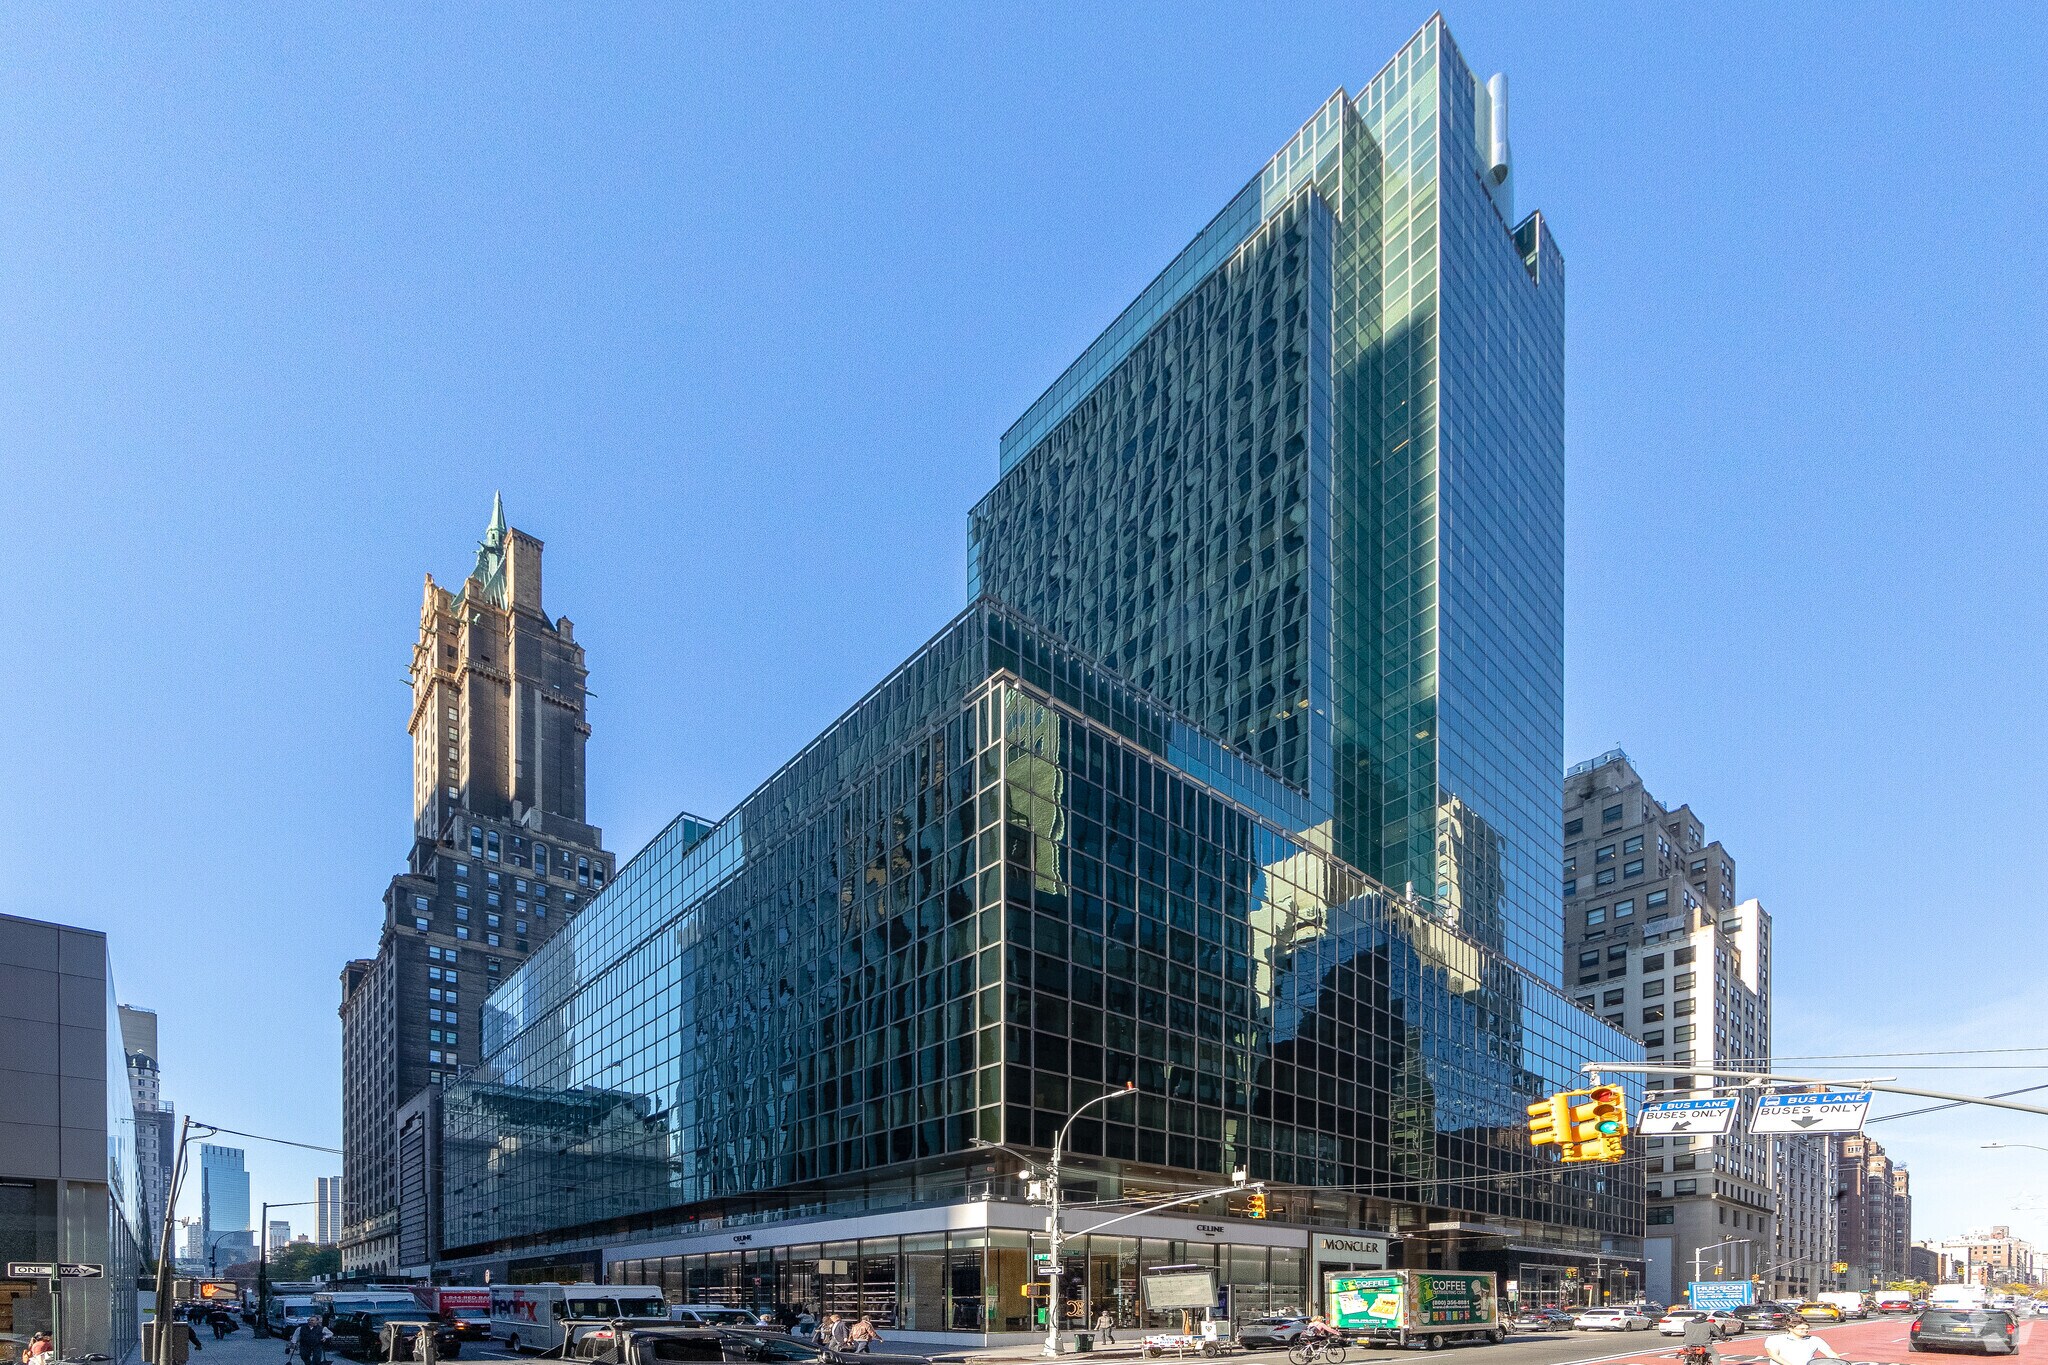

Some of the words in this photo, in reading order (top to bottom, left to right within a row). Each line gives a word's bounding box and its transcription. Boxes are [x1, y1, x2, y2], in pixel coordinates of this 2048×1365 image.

[1787, 1096, 1818, 1104] BUS
[1822, 1093, 1866, 1102] LANE
[1666, 1102, 1691, 1110] BUS
[1694, 1100, 1729, 1109] LANE
[1760, 1106, 1811, 1116] BUSES
[1819, 1104, 1863, 1113] ONLY
[1646, 1111, 1687, 1120] BUSES
[1691, 1109, 1727, 1118] ONLY
[1197, 1224, 1224, 1233] CELINE
[733, 1234, 752, 1242] CELINE
[1322, 1239, 1379, 1253] MONCLER
[1356, 1280, 1390, 1289] COFFEE
[1433, 1281, 1467, 1290] COFFEE
[492, 1289, 538, 1323] FedEx
